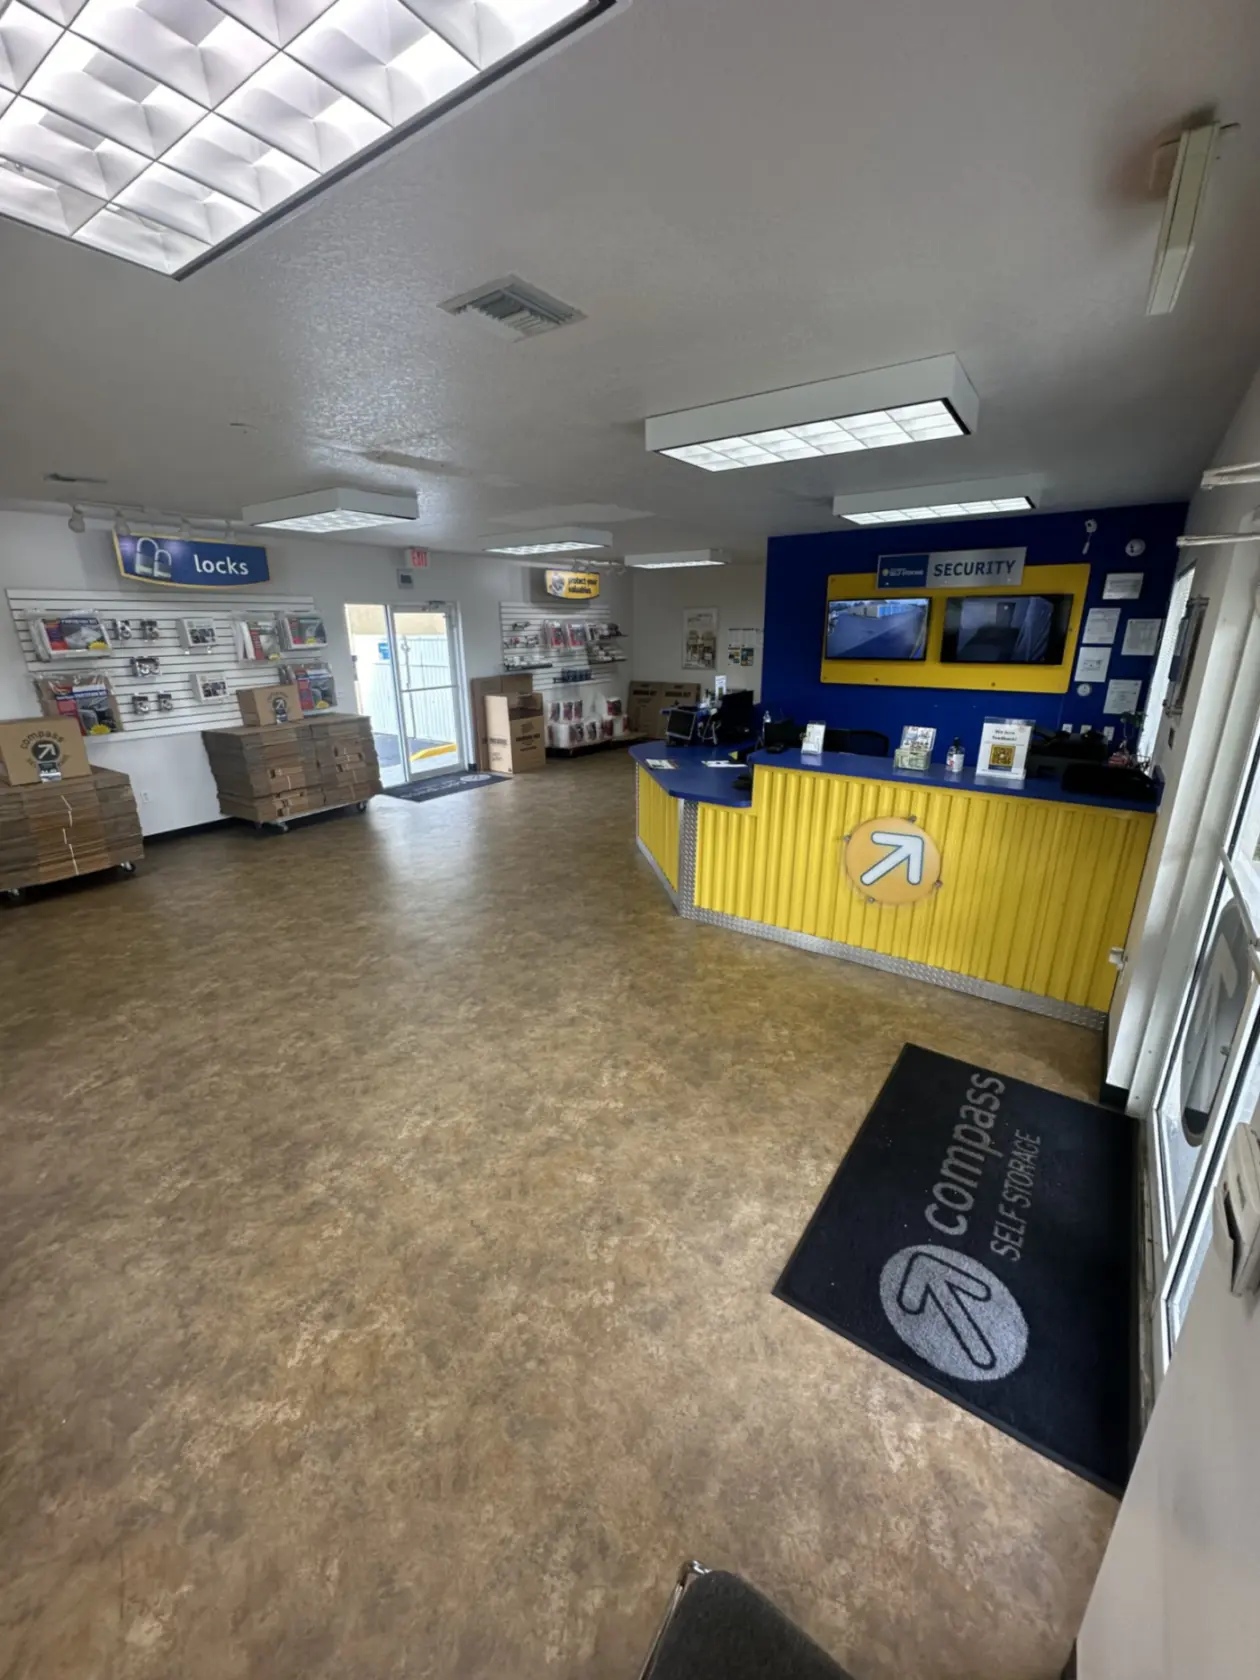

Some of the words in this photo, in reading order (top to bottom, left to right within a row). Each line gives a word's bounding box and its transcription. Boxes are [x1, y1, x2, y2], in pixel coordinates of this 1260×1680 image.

[193, 554, 249, 575] locks
[411, 549, 428, 567] EXIT
[934, 560, 1016, 577] SECURITY
[20, 730, 65, 750] compass
[925, 1073, 1005, 1236] compass
[1002, 1129, 1041, 1208] STORAGE
[990, 1203, 1027, 1262] SELF
